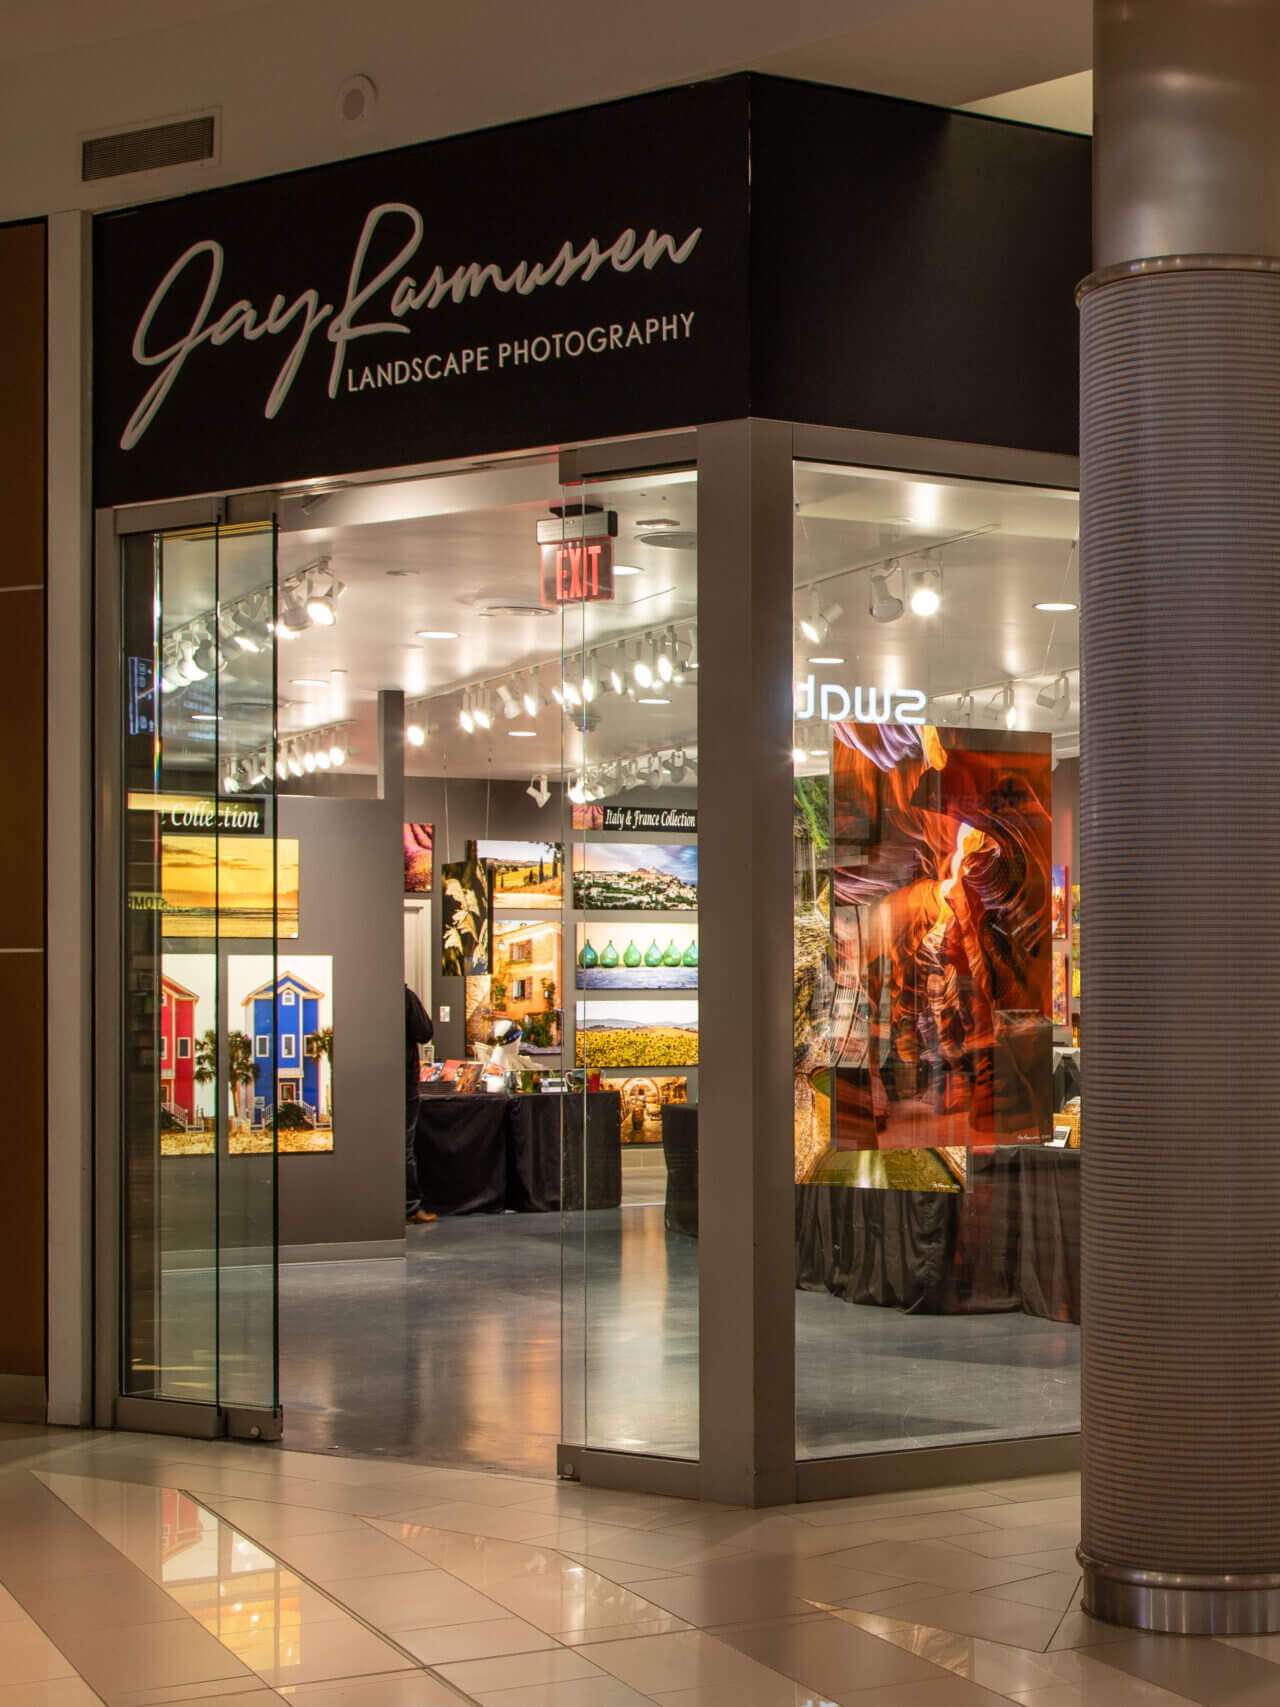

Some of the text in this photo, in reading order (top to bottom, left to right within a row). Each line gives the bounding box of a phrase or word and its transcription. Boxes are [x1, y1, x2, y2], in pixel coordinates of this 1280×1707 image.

[119, 202, 703, 450] Jay Rasmussen
[347, 311, 696, 392] LANDSCAPE PHOTOGRAPHY
[555, 545, 602, 600] EXIT
[604, 808, 696, 830] Italy & France Collection
